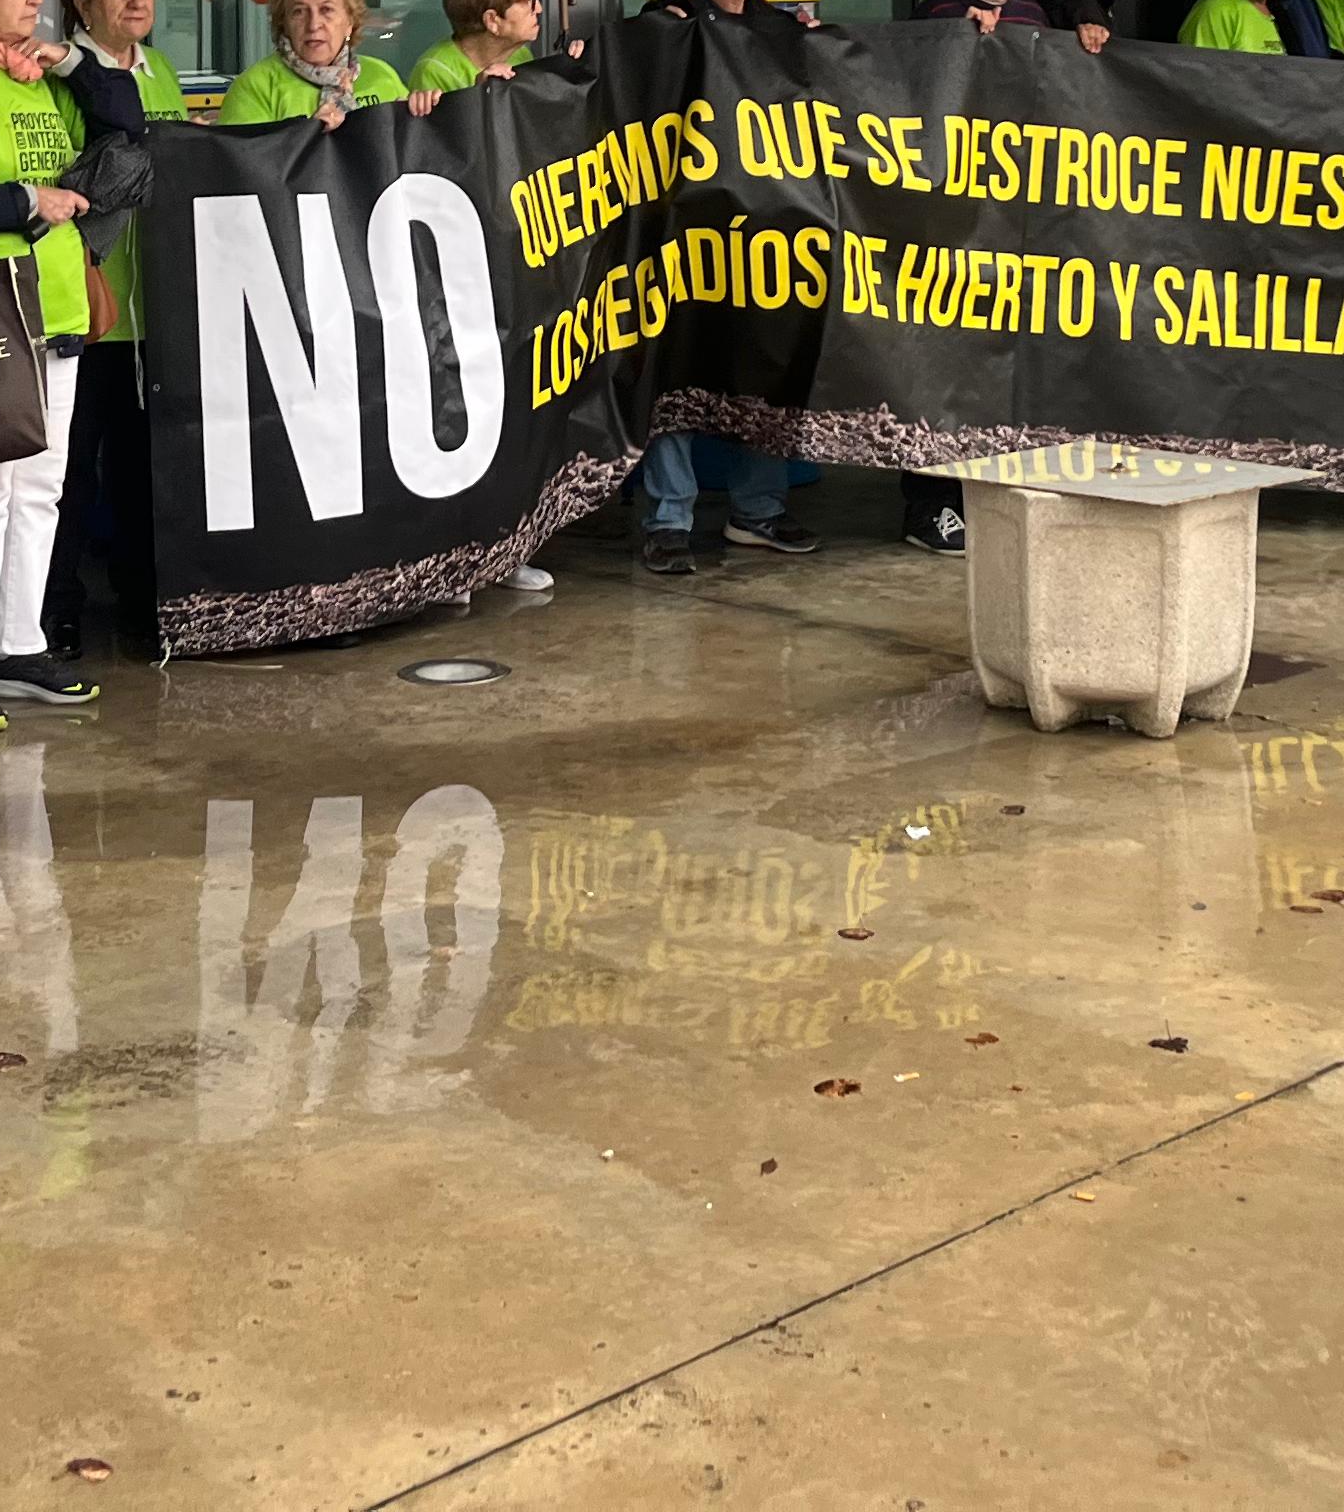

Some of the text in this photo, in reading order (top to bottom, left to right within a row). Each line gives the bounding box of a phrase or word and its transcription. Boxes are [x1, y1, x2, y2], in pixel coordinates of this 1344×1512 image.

[508, 99, 719, 271] QUEREMOS
[735, 97, 850, 180] QUE
[856, 111, 933, 193] SE
[943, 114, 1188, 217] DESTROCE
[193, 172, 508, 533] NO
[584, 215, 832, 367] REGADÍOS
[842, 230, 889, 322] DE
[895, 243, 1096, 339] HUERTO
[1109, 261, 1141, 342] Y
